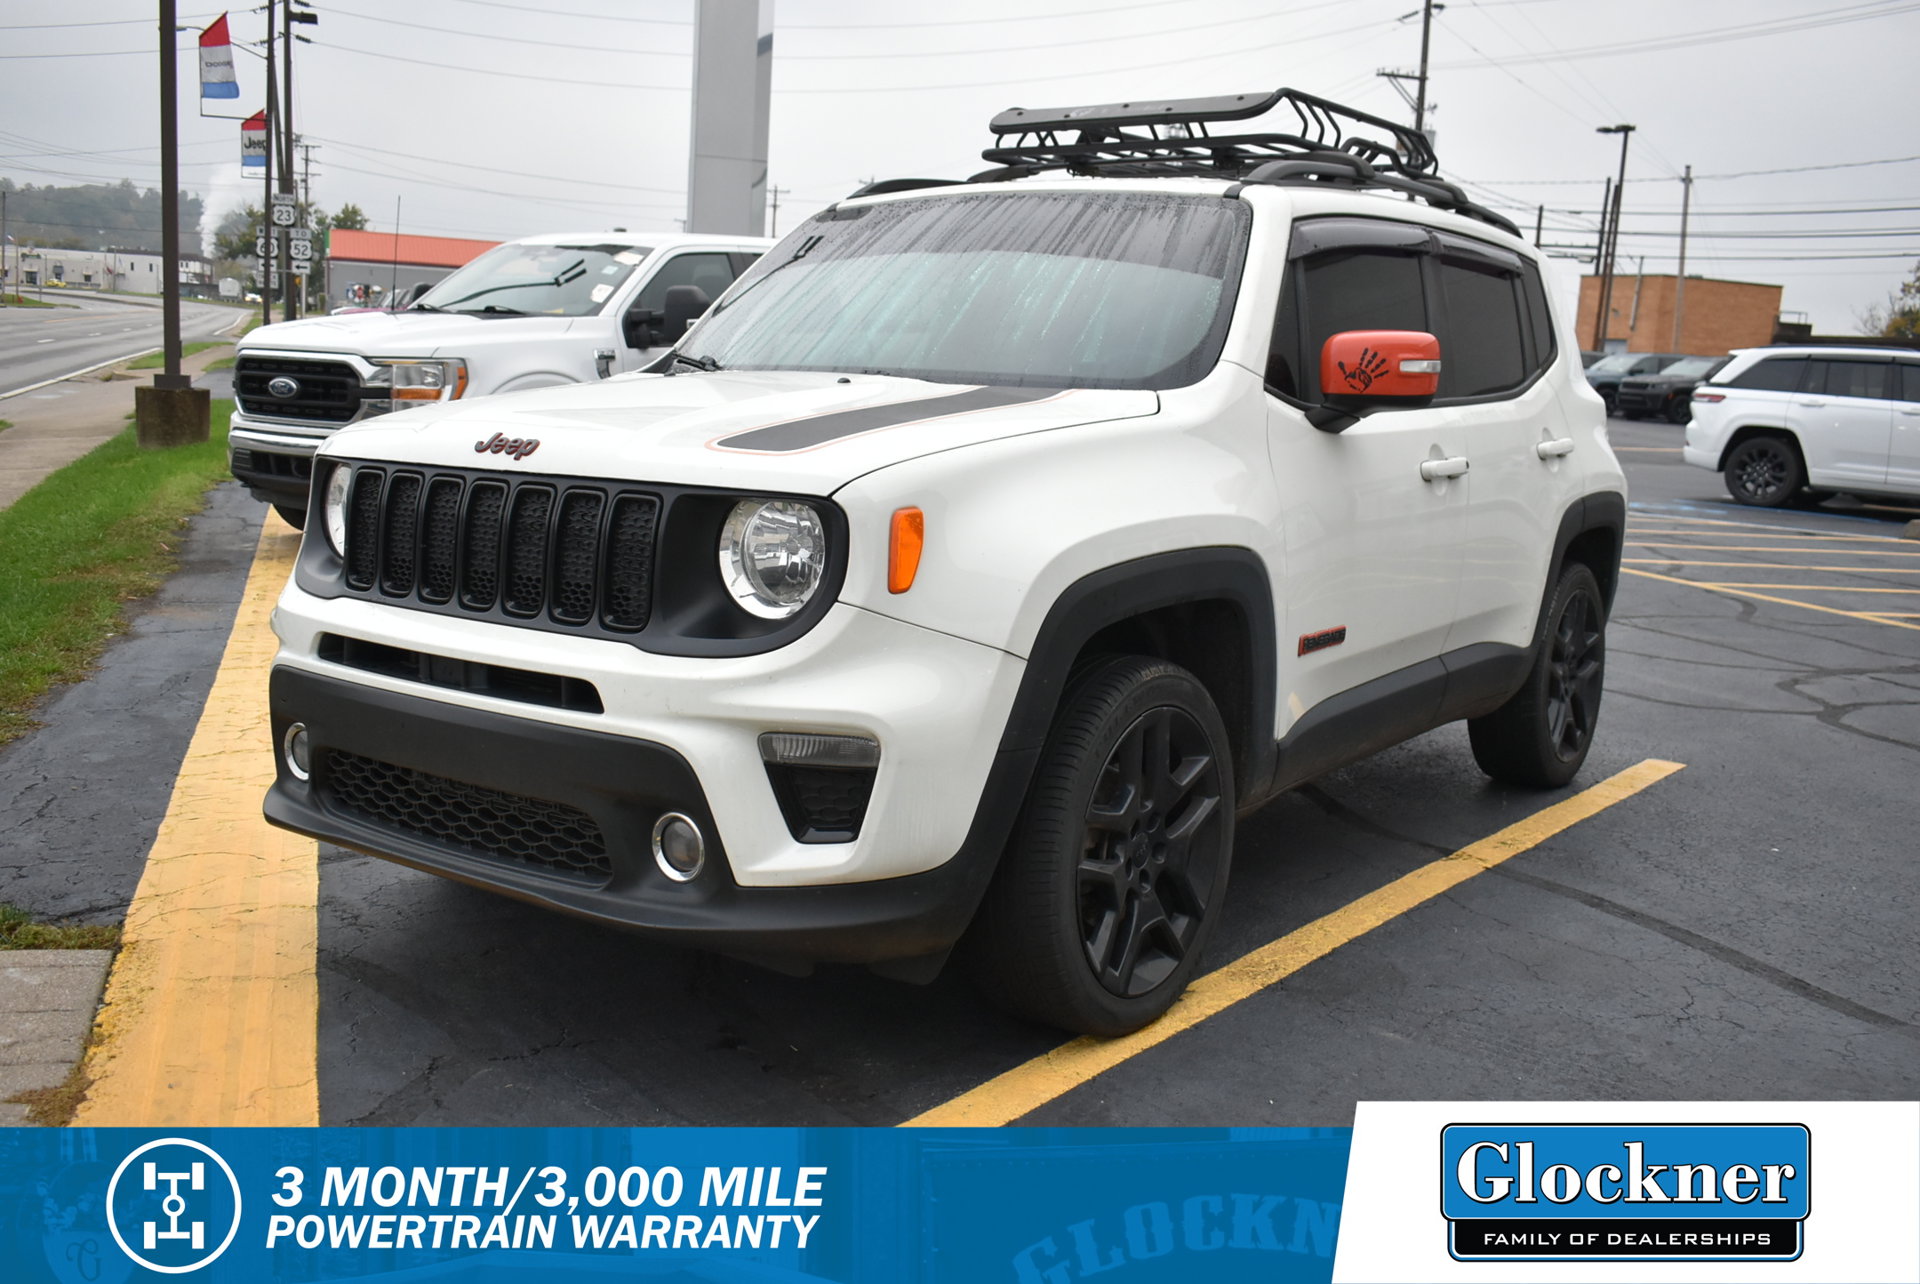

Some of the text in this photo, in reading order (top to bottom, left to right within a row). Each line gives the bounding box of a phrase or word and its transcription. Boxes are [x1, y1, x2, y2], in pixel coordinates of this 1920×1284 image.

[277, 210, 292, 221] 23
[294, 244, 308, 256] 52
[475, 432, 540, 461] Jeep
